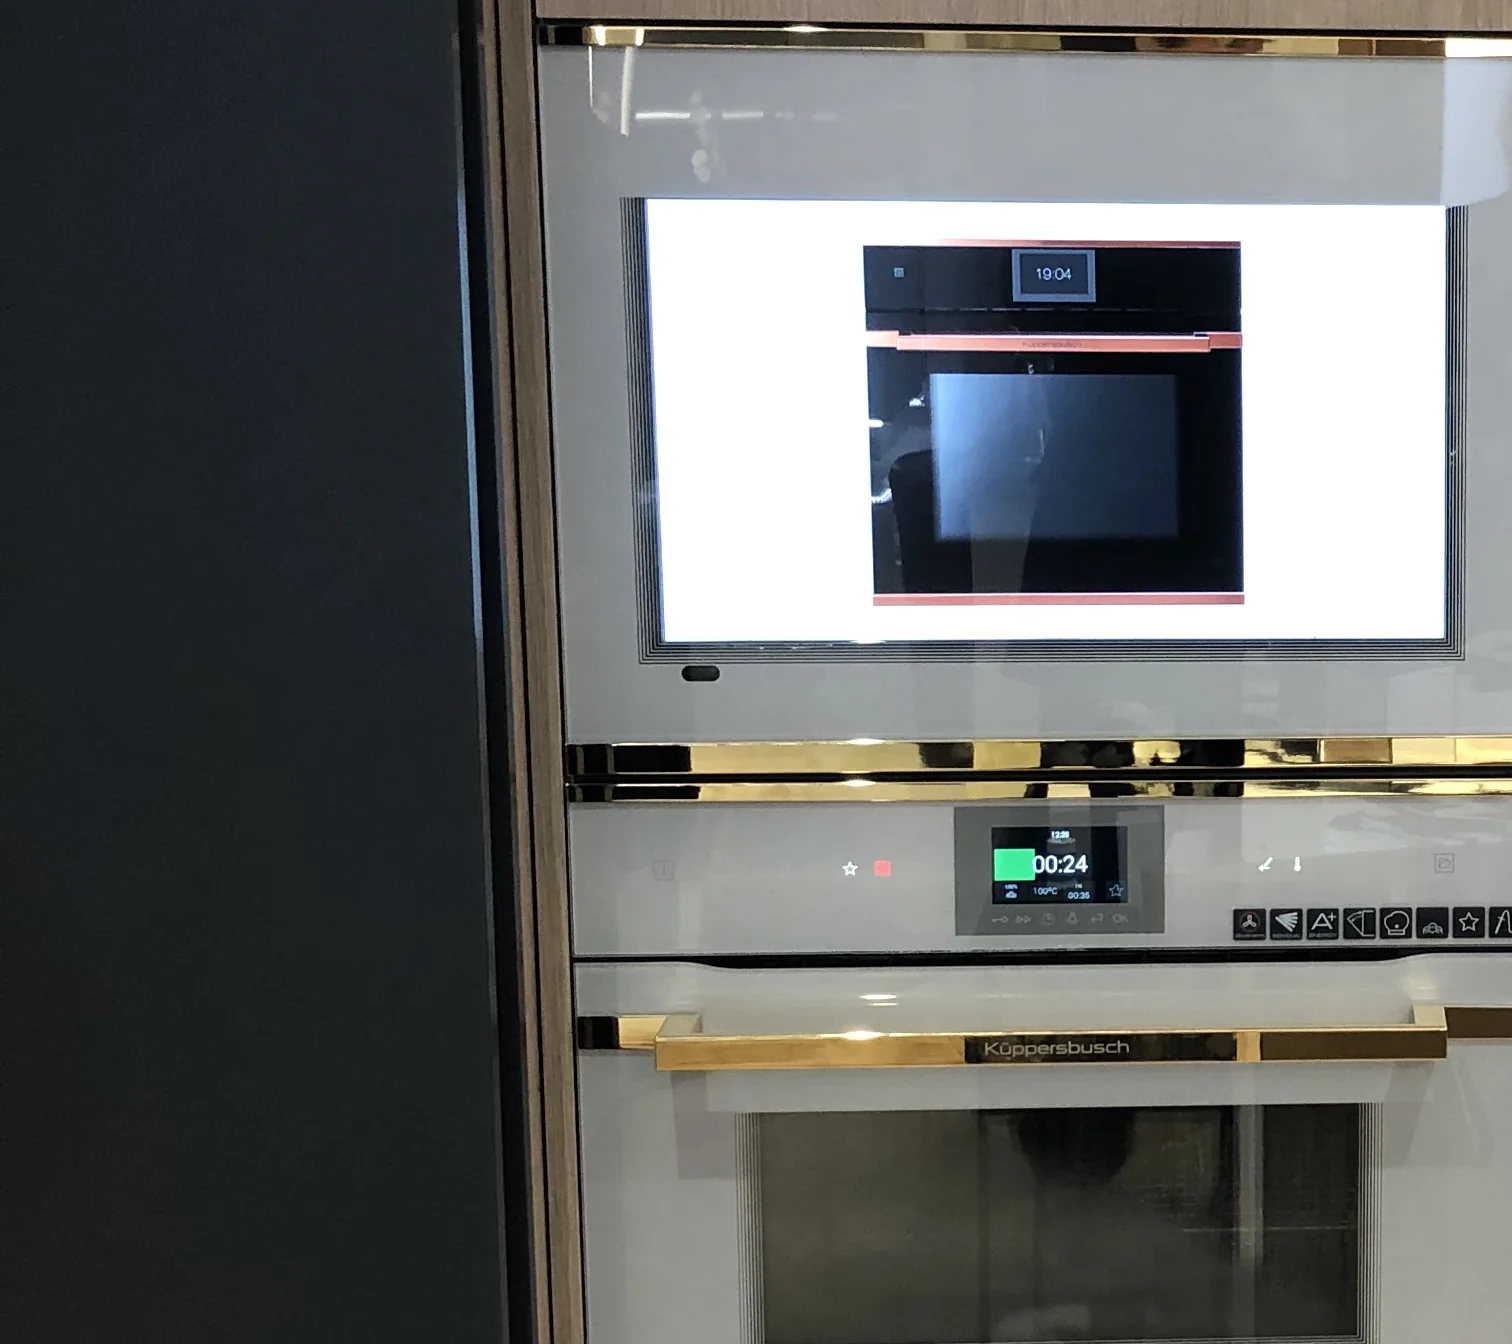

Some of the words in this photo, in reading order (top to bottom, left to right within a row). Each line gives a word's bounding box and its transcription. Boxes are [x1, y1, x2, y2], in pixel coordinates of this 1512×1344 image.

[1036, 267, 1072, 281] 19:04
[1032, 855, 1089, 874] 00:24
[1067, 892, 1091, 900] 00:35
[1112, 913, 1129, 924] OK
[984, 1040, 1130, 1057] Küppersbusch
